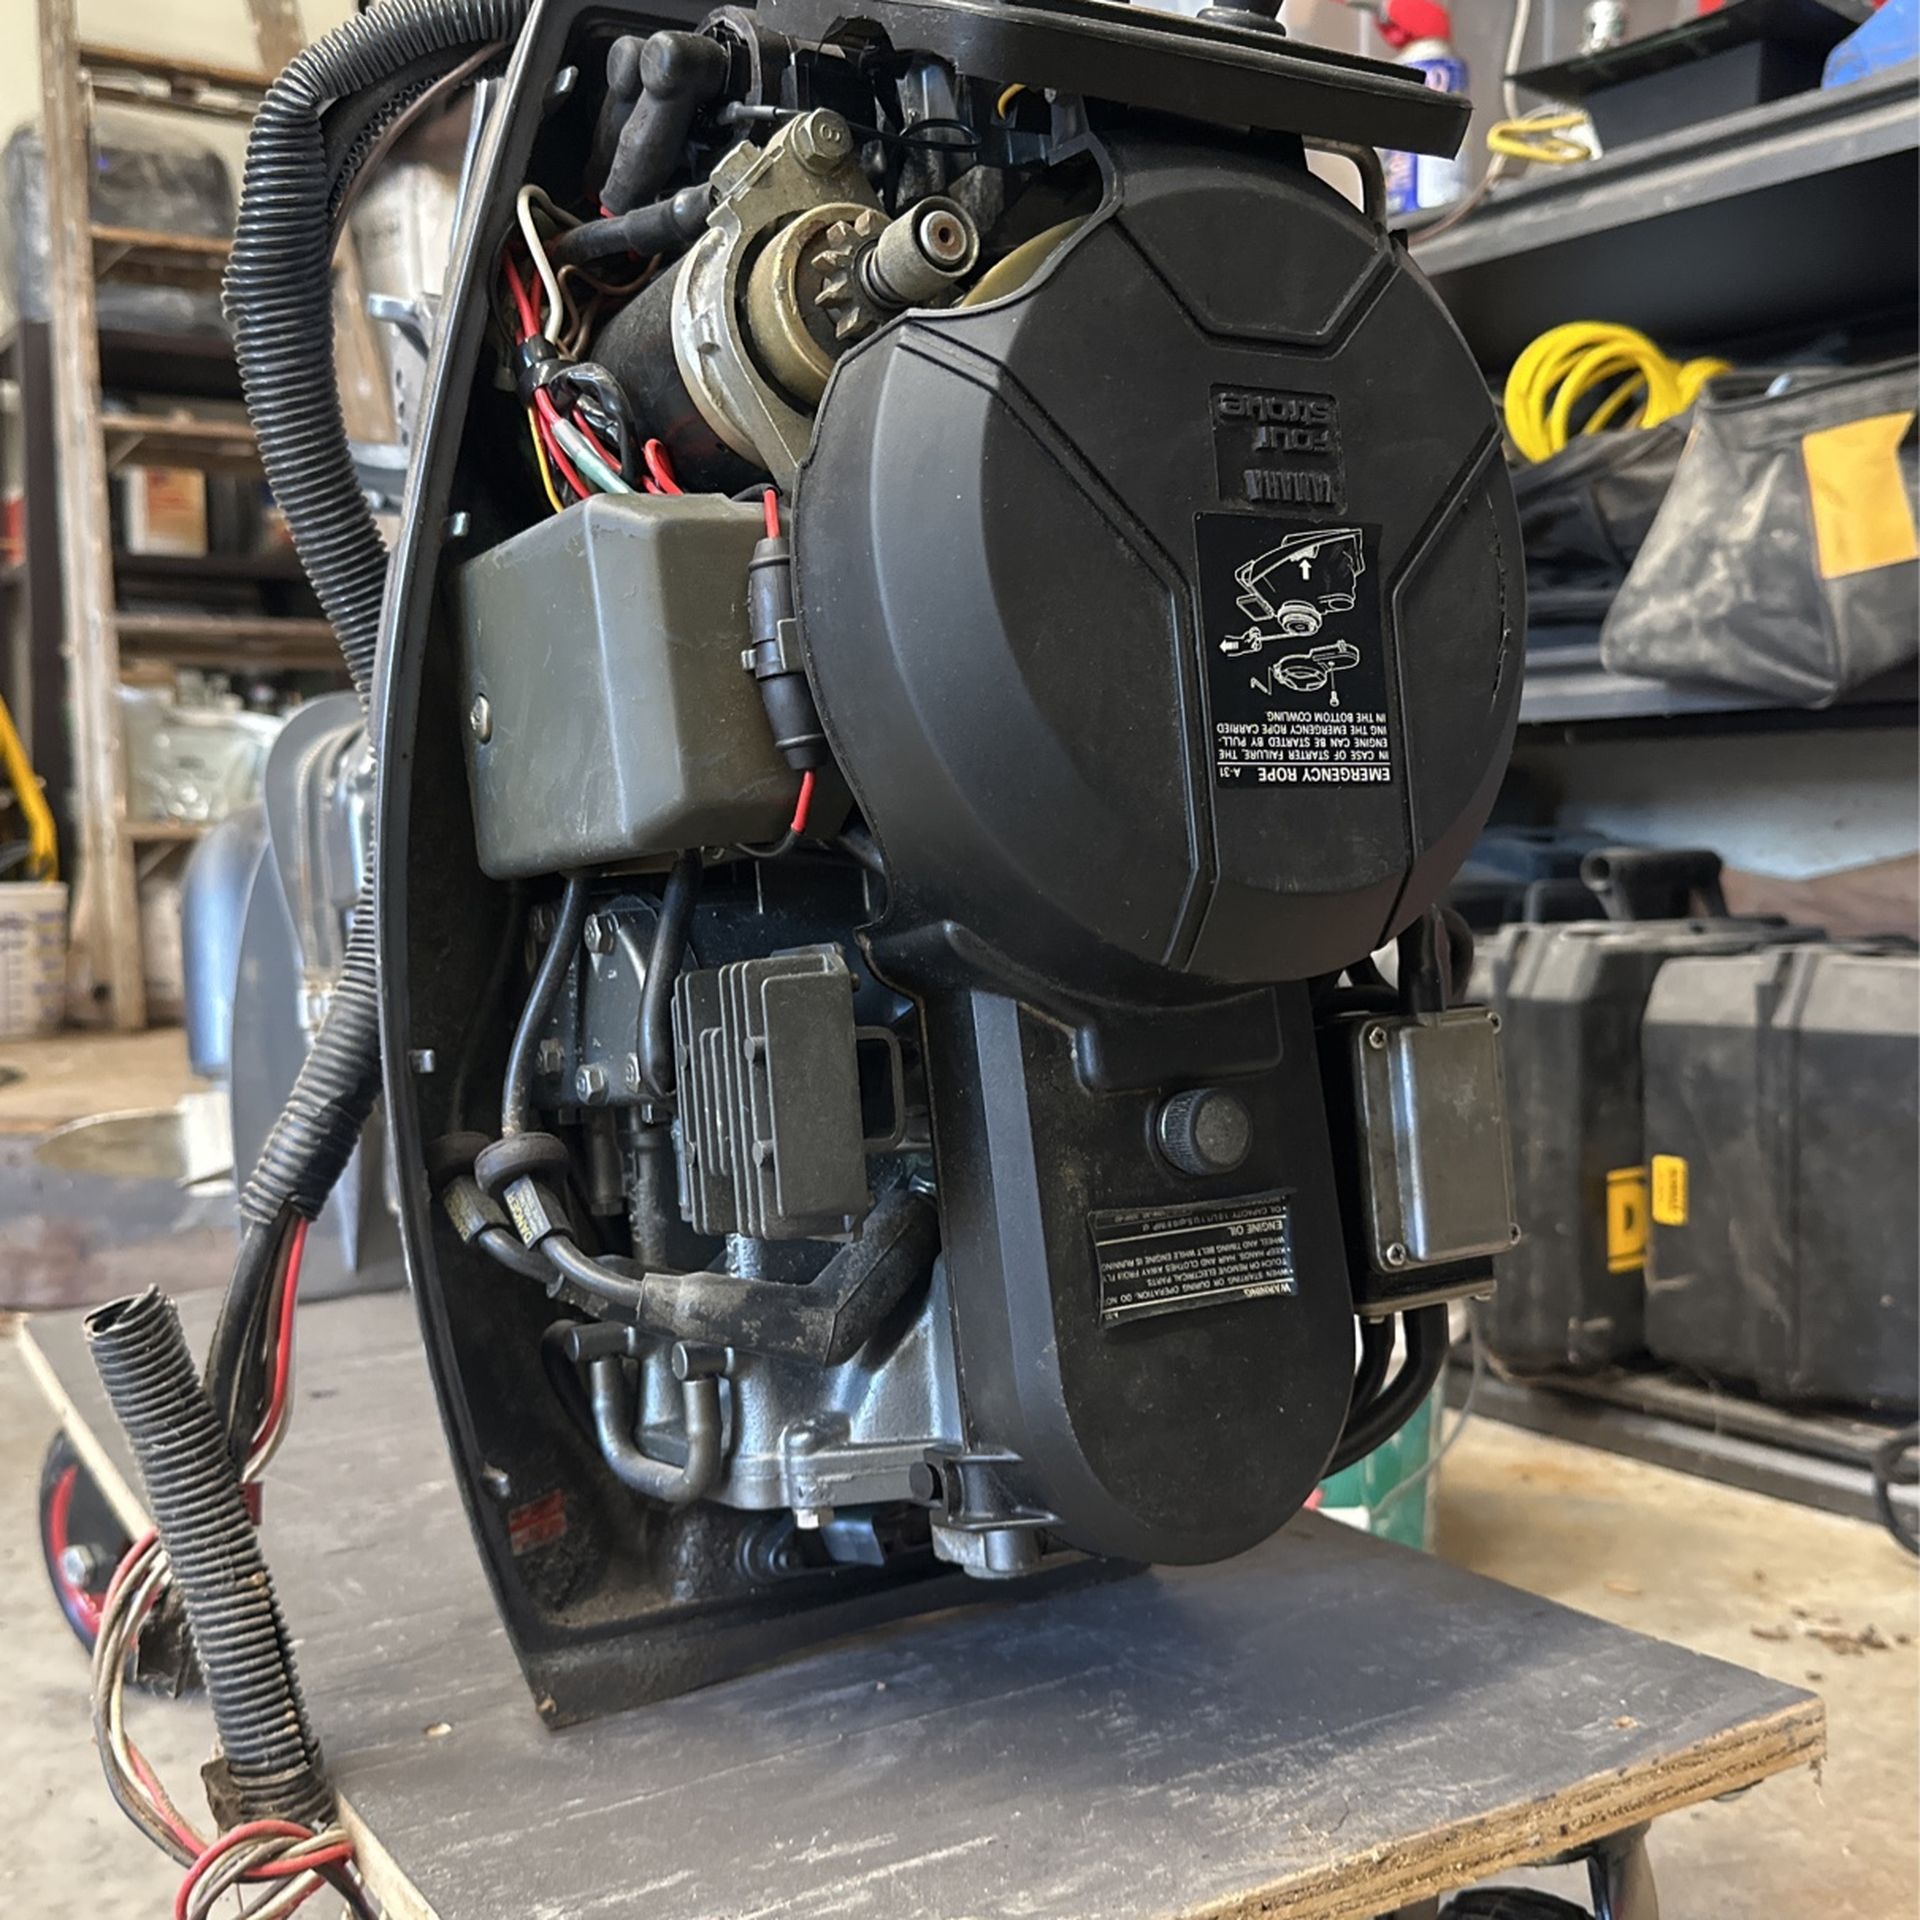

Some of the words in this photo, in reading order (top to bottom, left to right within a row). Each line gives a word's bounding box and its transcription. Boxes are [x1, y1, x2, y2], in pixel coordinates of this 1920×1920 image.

[1314, 712, 1353, 722] BOTTOM
[1356, 713, 1373, 722] THE
[1376, 713, 1386, 722] IN
[1217, 723, 1259, 734] CARRIED
[1262, 724, 1286, 734] ROPE
[1290, 725, 1346, 735] EMERGENCY
[1350, 725, 1366, 735] THE
[1370, 726, 1387, 735] ING
[1218, 736, 1246, 747] PULL-
[1252, 737, 1264, 746] BY
[1268, 737, 1310, 747] STARTED
[1315, 738, 1326, 747] BE
[1330, 738, 1350, 747] CAN
[1354, 738, 1388, 747] ENGINE
[1218, 749, 1238, 759] THE
[1288, 750, 1329, 759] STARTER
[1334, 751, 1346, 760] OF
[1351, 751, 1375, 760] CASE
[1379, 751, 1389, 760] IN
[1219, 767, 1241, 777] A-31
[1258, 767, 1297, 782] ROPE
[1302, 767, 1390, 781] EMERGENCY
[1232, 1207, 1268, 1218] CAPACITY
[1270, 1206, 1281, 1214] OIL
[1227, 1225, 1244, 1236] OIL
[1246, 1220, 1283, 1234] ENGINE
[1243, 1240, 1258, 1250] AND
[1260, 1236, 1285, 1246] WHEEL
[1197, 1246, 1215, 1257] BELT
[1216, 1243, 1241, 1253] TIMING
[1266, 1247, 1285, 1256] KEEP
[1145, 1254, 1172, 1265] ENGINE
[1173, 1250, 1195, 1260] WHILE
[1218, 1254, 1236, 1263] HAIR
[1136, 1258, 1143, 1267] IS
[1165, 1260, 1199, 1271] CLOTHES
[1200, 1257, 1216, 1266] AND
[1249, 1262, 1260, 1271] OR
[1262, 1258, 1287, 1267] TOUCH
[1142, 1266, 1162, 1276] AWAY
[1218, 1264, 1248, 1275] REMOVE
[1266, 1268, 1288, 1277] WHEN
[1173, 1268, 1216, 1284] ELECTRICAL
[1227, 1272, 1263, 1284] STARTING
[1182, 1280, 1210, 1292] DURING
[1213, 1278, 1225, 1287] OR
[1243, 1283, 1292, 1298] WARNING
[1121, 1294, 1132, 1303] DO
